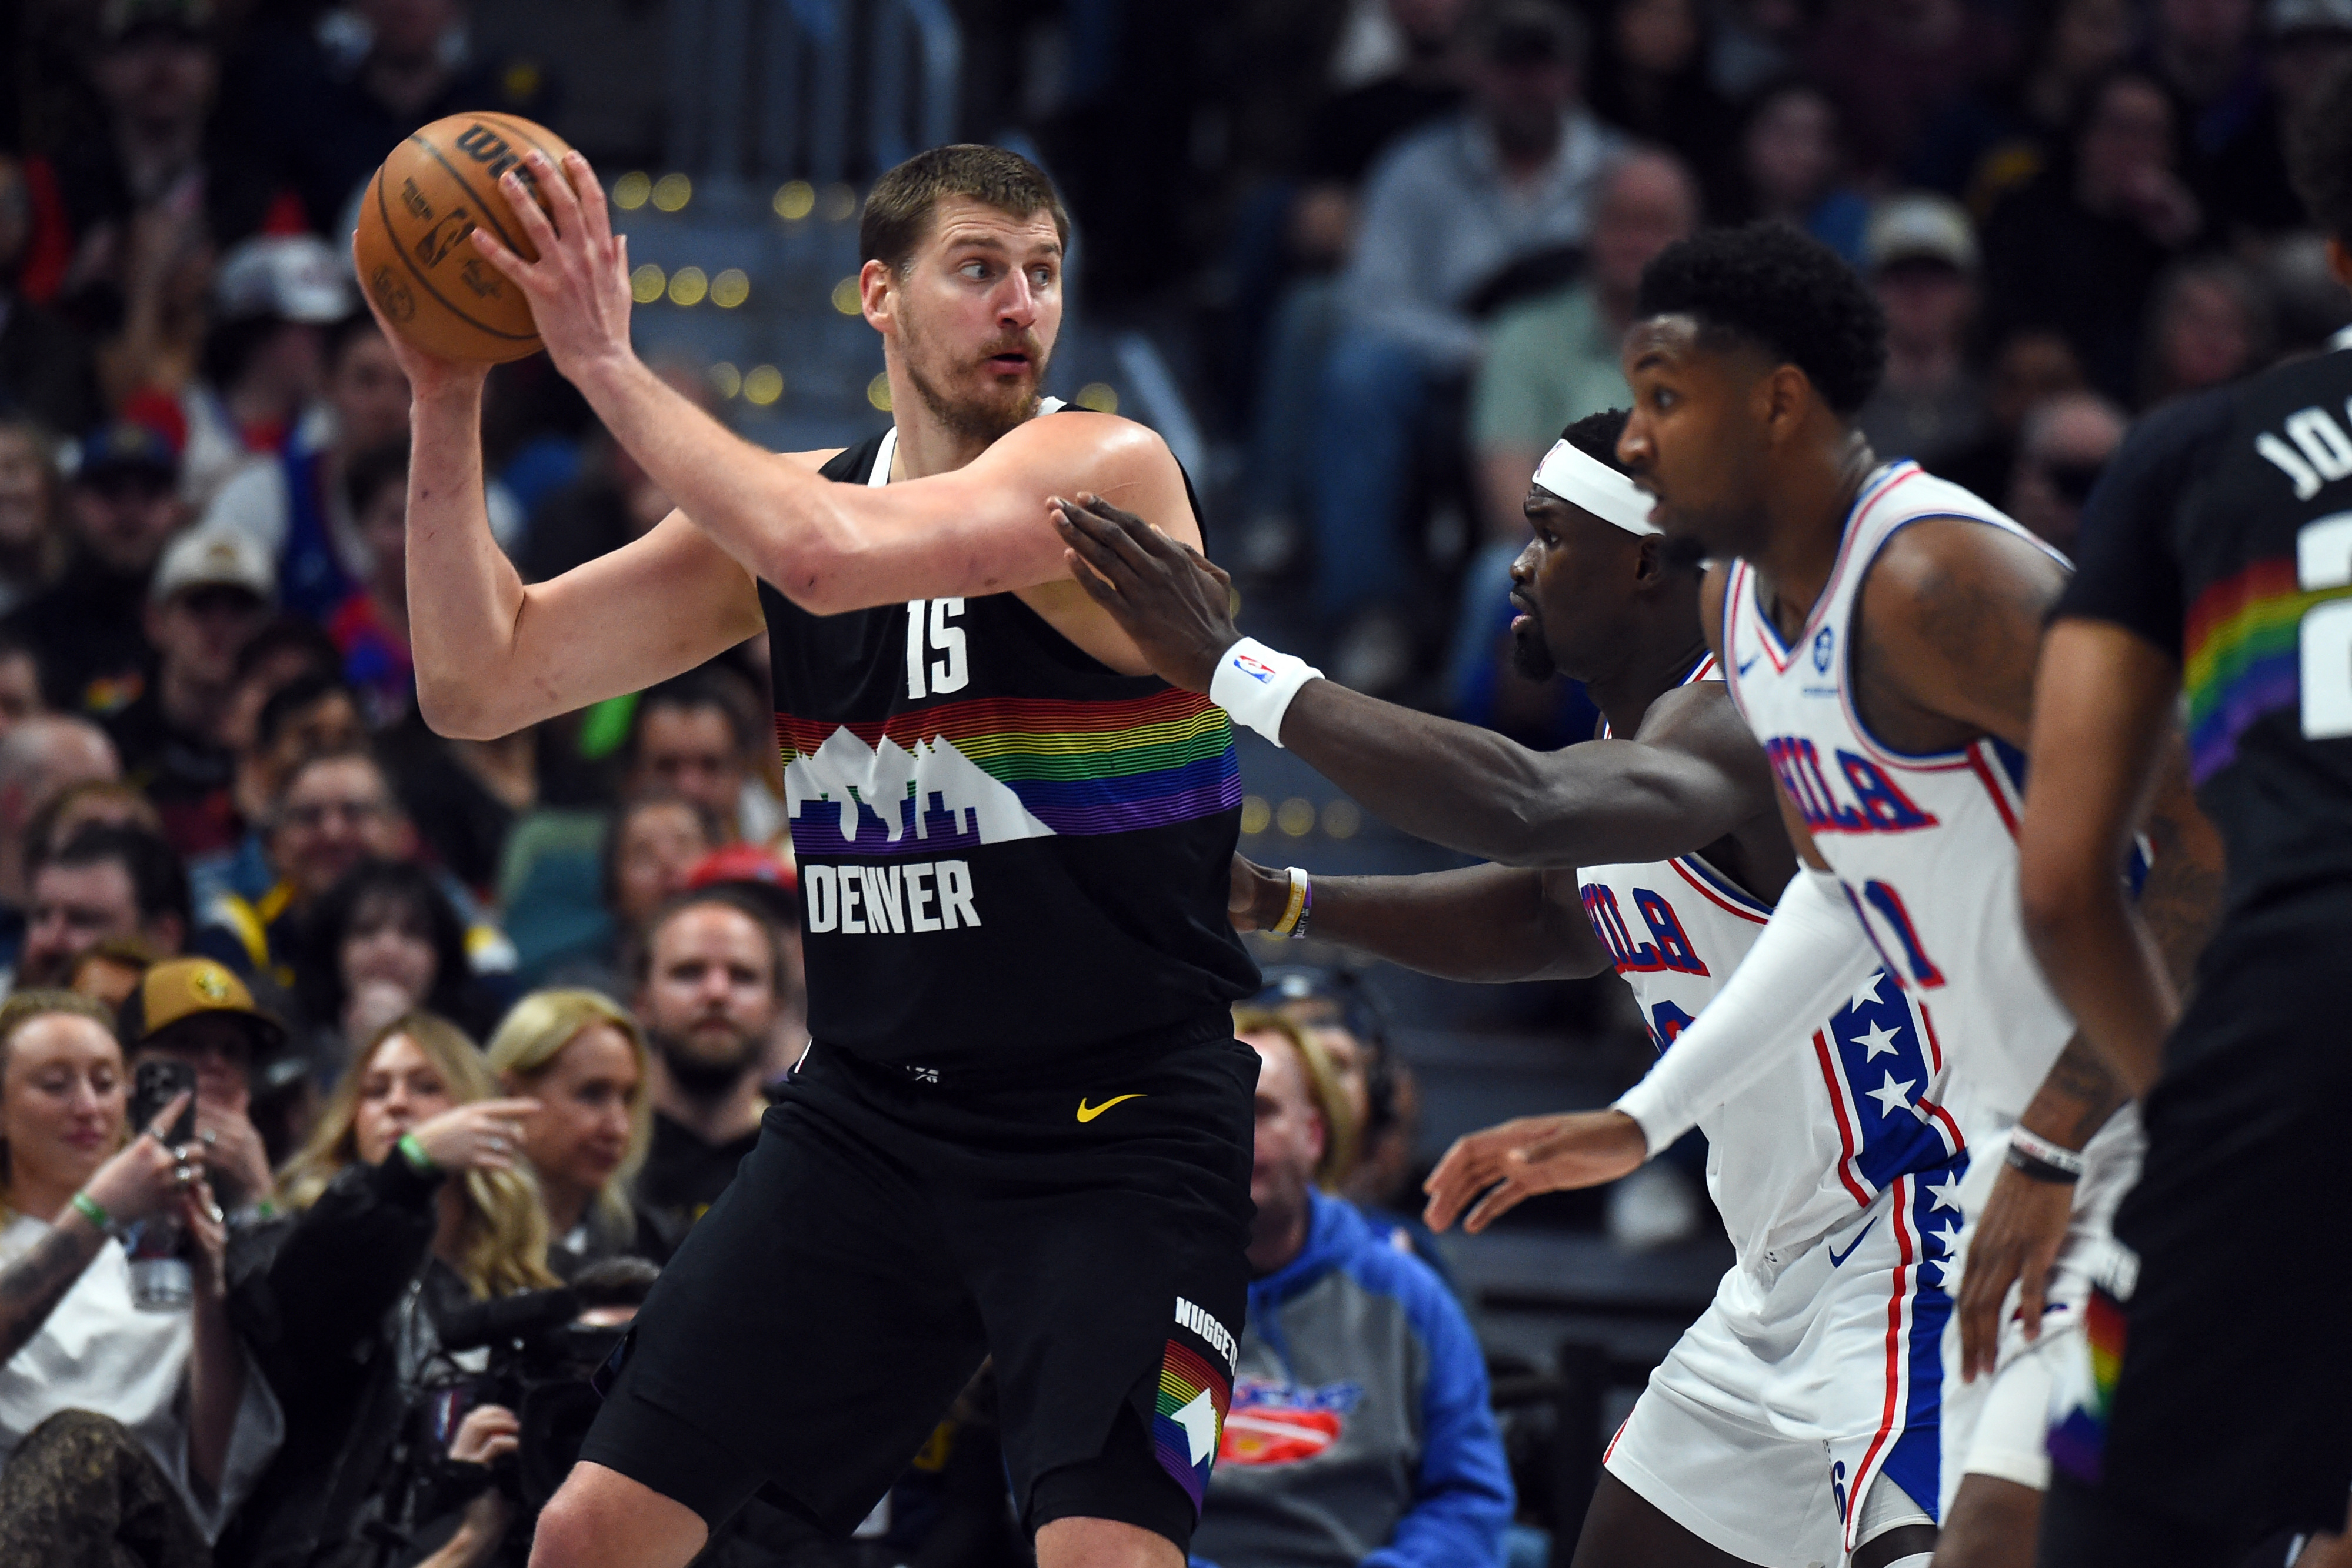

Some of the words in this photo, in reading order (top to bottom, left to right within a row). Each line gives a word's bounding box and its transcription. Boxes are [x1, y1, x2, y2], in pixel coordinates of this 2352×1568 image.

[2256, 395, 2352, 502] JO
[907, 597, 969, 700] 15
[804, 860, 981, 934] DENVER
